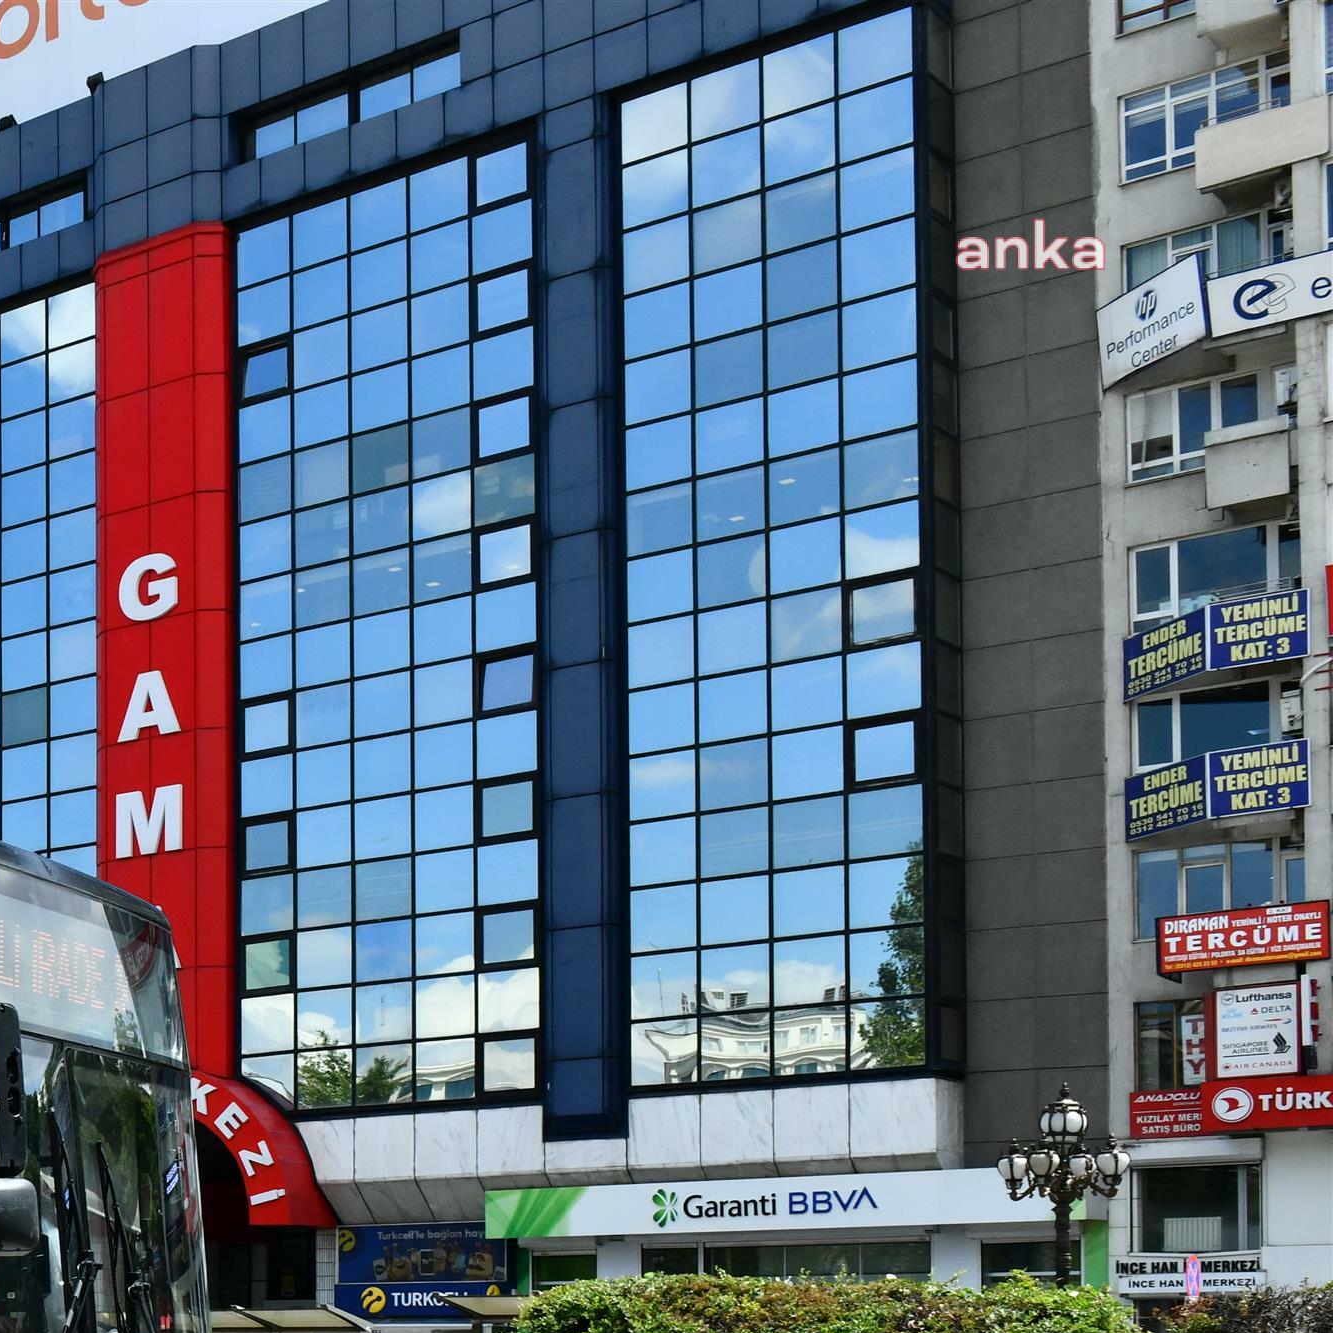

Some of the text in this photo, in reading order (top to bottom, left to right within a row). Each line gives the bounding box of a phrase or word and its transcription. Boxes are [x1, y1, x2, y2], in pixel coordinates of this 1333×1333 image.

[1106, 300, 1195, 359] Performance
[1130, 333, 1179, 368] Center
[1220, 592, 1300, 624] YEMİNLİ
[1142, 619, 1187, 650] ENDER
[1214, 614, 1306, 645] TERCÜME
[1127, 632, 1203, 680] TERCÜME
[1230, 637, 1290, 662] KAT: 3
[1127, 655, 1203, 689] 0530 541 70 16
[1127, 662, 1203, 696] 0312 425 59 44
[115, 552, 183, 860] GAM
[1220, 742, 1300, 772] YEMİNLİ
[1143, 765, 1188, 792] ENDER
[1214, 764, 1307, 793] TERCÜME
[1129, 780, 1203, 819] TERCÜME
[1231, 787, 1291, 811] KAT: 3
[1129, 803, 1204, 829] 0530 541 70 16
[1129, 810, 1204, 836] 0312 425 59 44
[1164, 915, 1229, 935] DIRAMAN
[1164, 923, 1322, 953] TERCÜME
[1235, 991, 1292, 1003] Lufthansa
[1261, 1005, 1292, 1014] DELTA
[1222, 1041, 1268, 1049] SINGAPORE
[1252, 1061, 1293, 1069] CANADA
[1133, 1087, 1333, 1112] ANADOLU TÜRK
[1136, 1114, 1175, 1124] KIZILAY
[1142, 1125, 1170, 1134] SATIŞ
[683, 1186, 878, 1219] Garanti BBVA
[377, 1231, 426, 1240] Turkcell'le
[427, 1229, 462, 1240] bağlan
[1116, 1260, 1146, 1274] İNCE
[1151, 1260, 1178, 1273] HAN
[1201, 1257, 1260, 1272] MERKEZİ
[1128, 1276, 1256, 1288] İNCE HAN MERKEZİ
